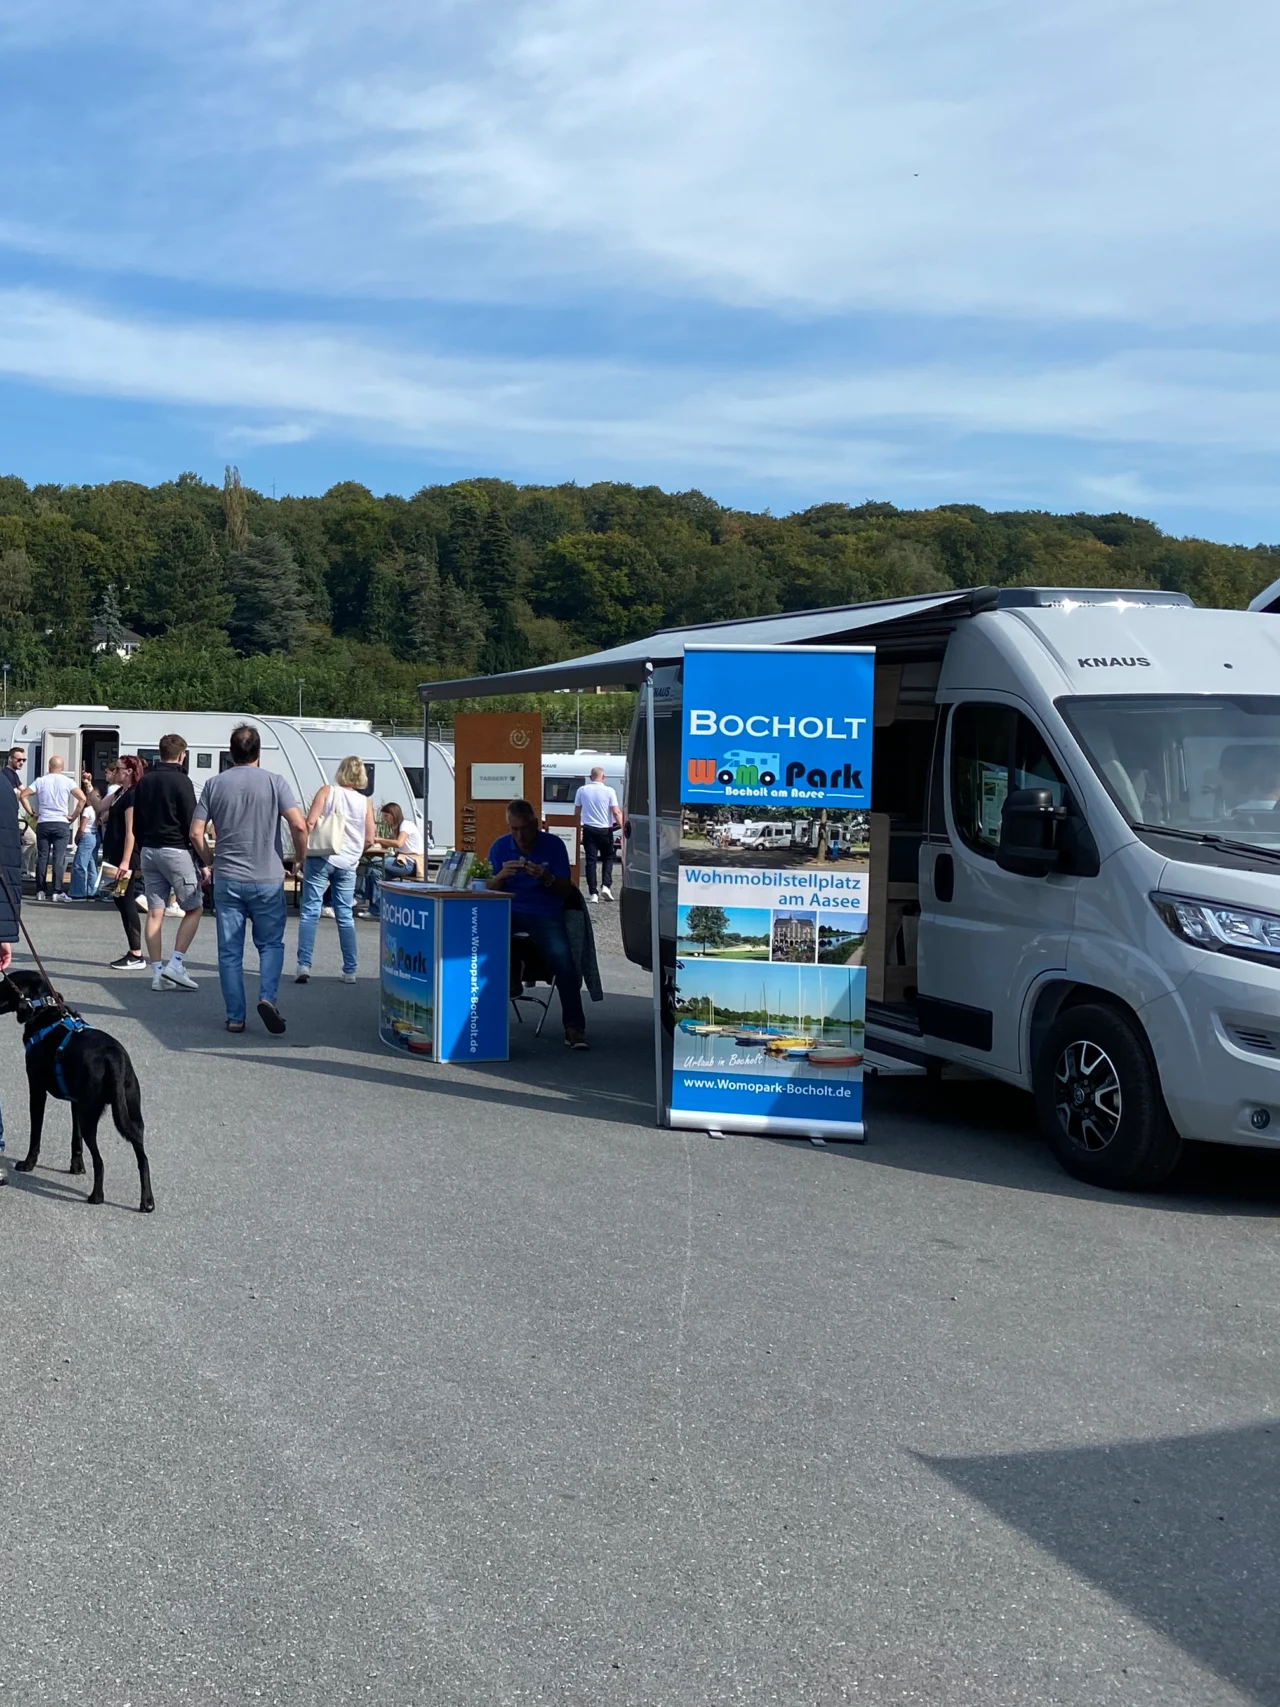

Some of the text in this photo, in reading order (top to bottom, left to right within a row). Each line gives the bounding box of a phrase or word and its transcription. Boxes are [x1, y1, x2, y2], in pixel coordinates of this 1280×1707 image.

[1077, 657, 1151, 668] KNAUS
[653, 687, 671, 697] NAUS
[689, 709, 867, 739] BOCHOLT
[785, 761, 864, 789] Park
[725, 786, 825, 799] Bocholt am Aasee
[685, 869, 861, 892] Wohnmobilstellplatz
[778, 893, 861, 909] am Aasee
[382, 897, 429, 930] BOCHOLT
[470, 906, 479, 1053] www.Womopark-Bocholt.de
[683, 1053, 763, 1068] Urlaub in Bocholt
[683, 1078, 851, 1098] www.Womopark-Bocholt.de
